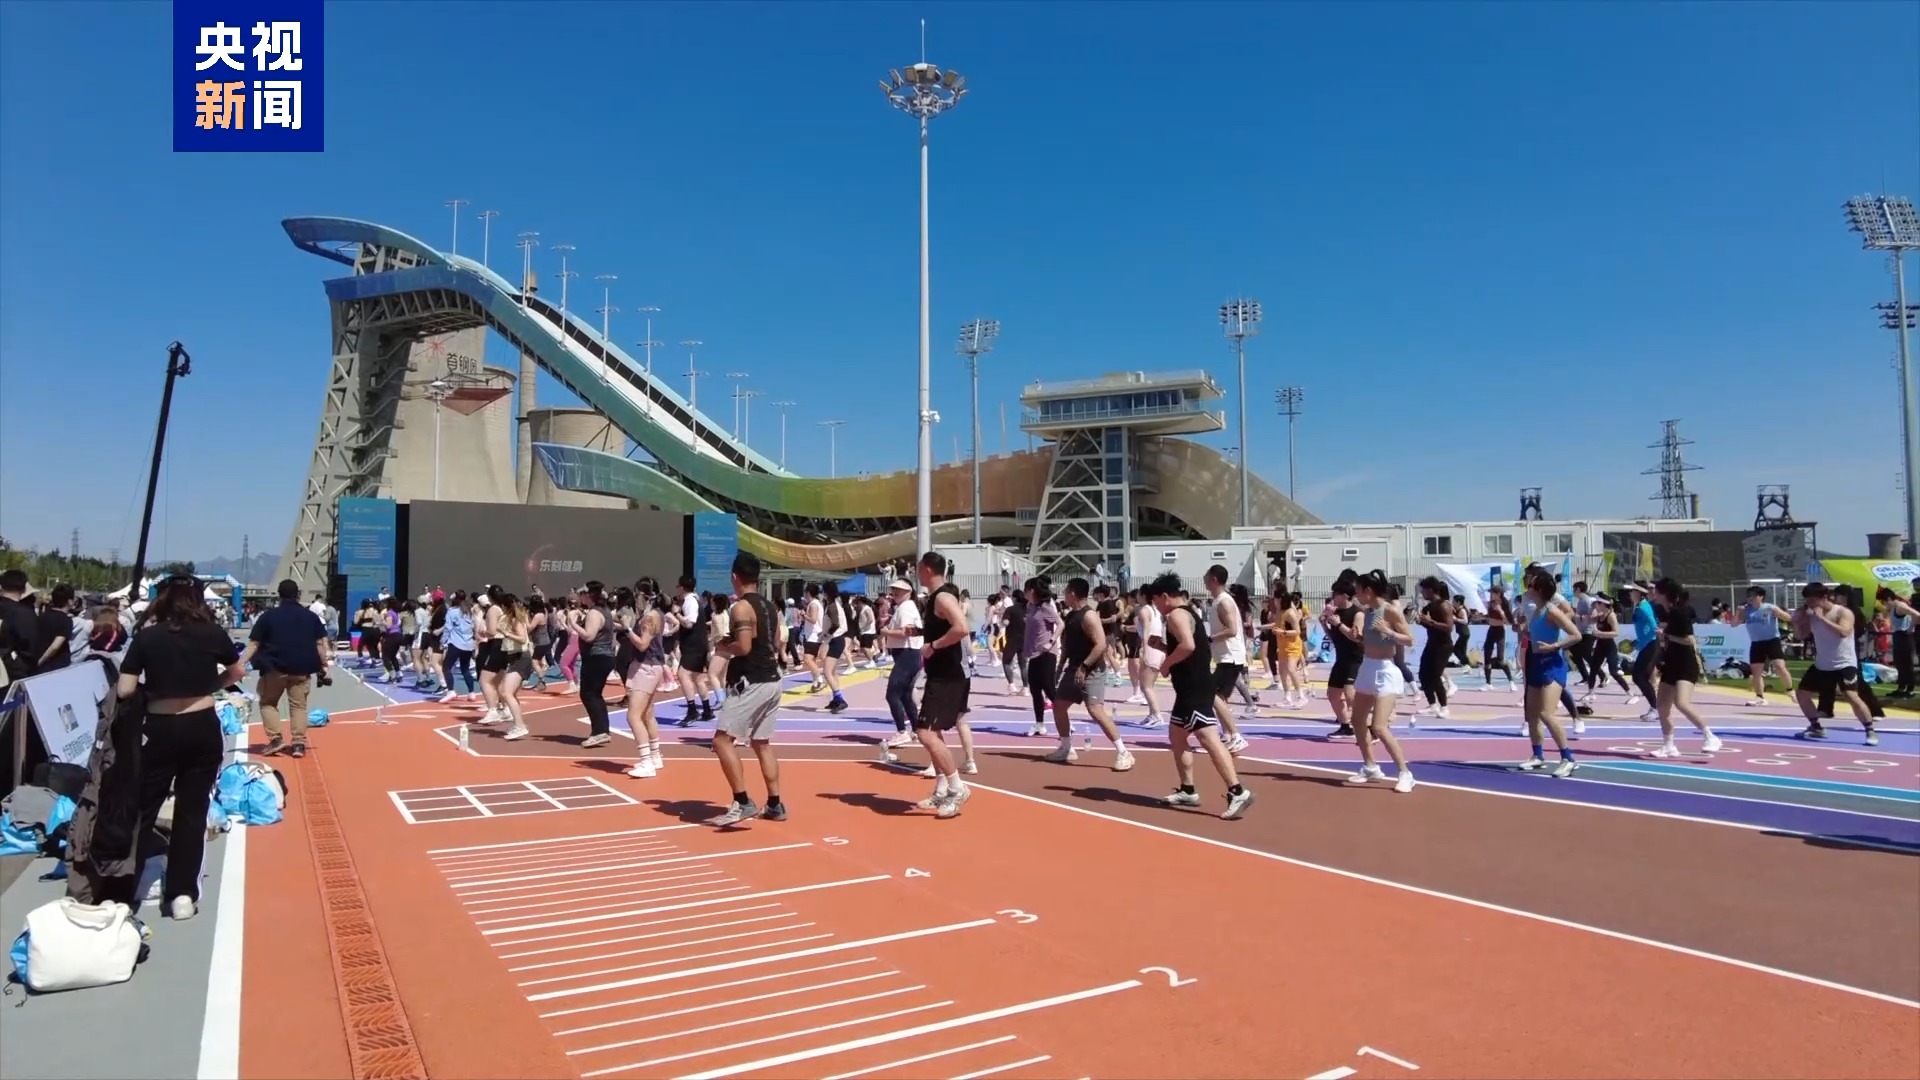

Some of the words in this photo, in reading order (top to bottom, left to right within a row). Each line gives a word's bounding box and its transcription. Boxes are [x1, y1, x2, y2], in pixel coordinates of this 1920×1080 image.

[539, 559, 583, 572] 乐刻健身
[822, 836, 849, 845] 5
[904, 867, 931, 878] 4
[995, 908, 1039, 924] 3
[1138, 966, 1198, 987] 2
[1356, 1046, 1420, 1070] 1
